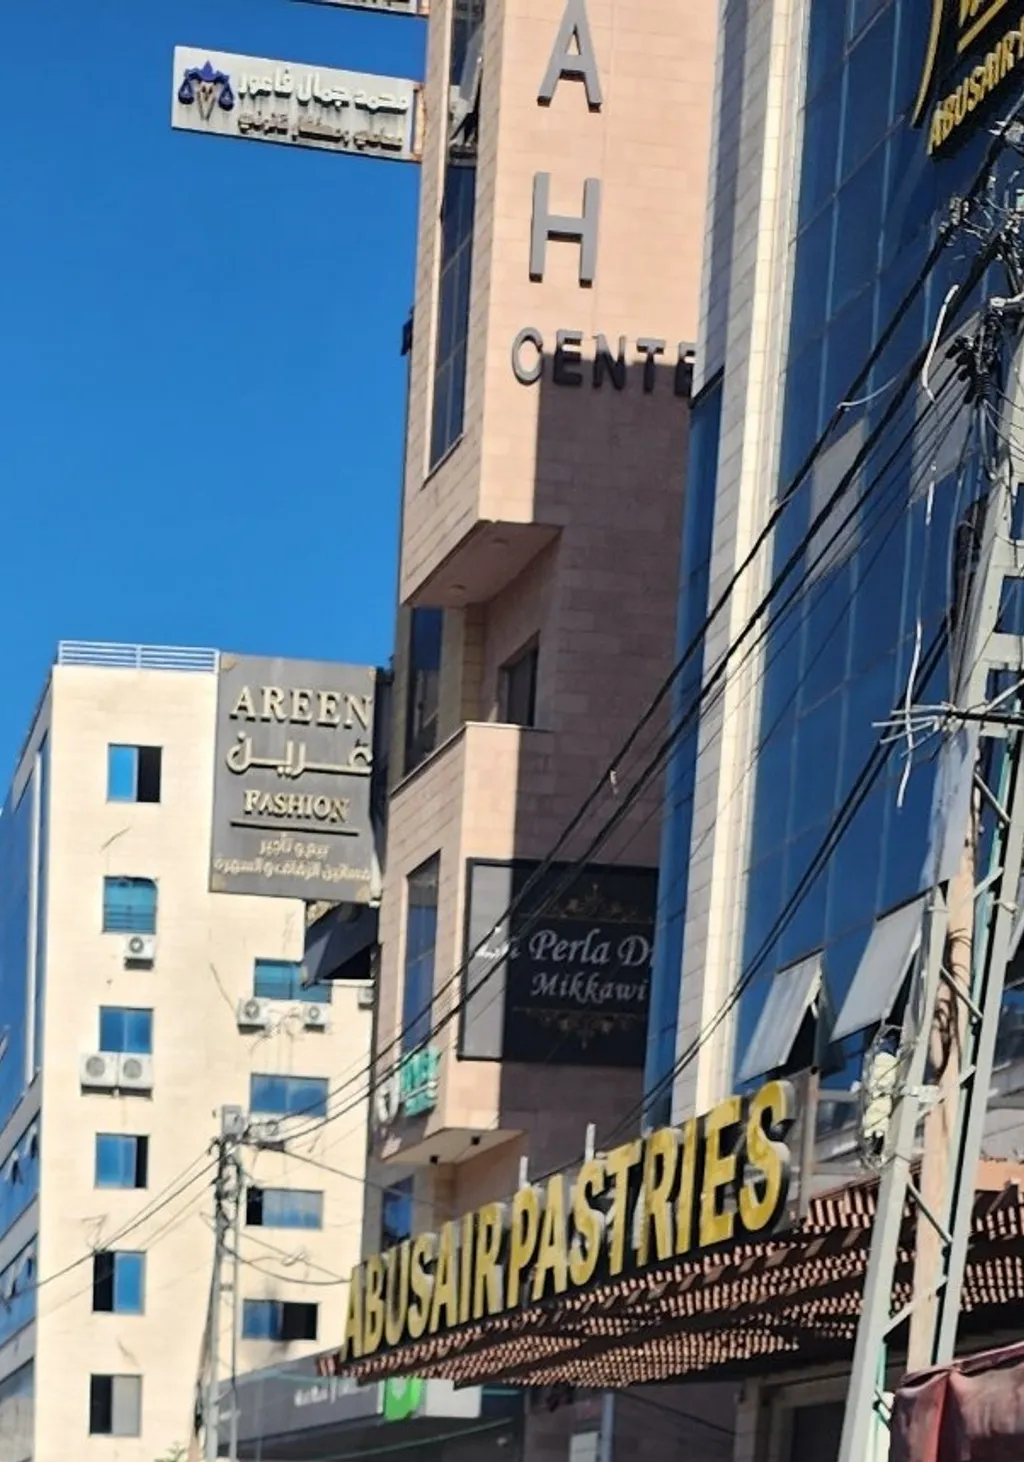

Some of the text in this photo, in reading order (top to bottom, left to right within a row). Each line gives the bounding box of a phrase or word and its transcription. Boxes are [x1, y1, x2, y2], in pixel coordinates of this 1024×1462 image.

[296, 71, 351, 112] جمال
[354, 88, 409, 115] محمد
[228, 684, 372, 730] AREEN
[243, 789, 351, 823] FASHION
[529, 928, 613, 965] Perla
[617, 935, 657, 967] D
[531, 972, 650, 1004] Mikkawi
